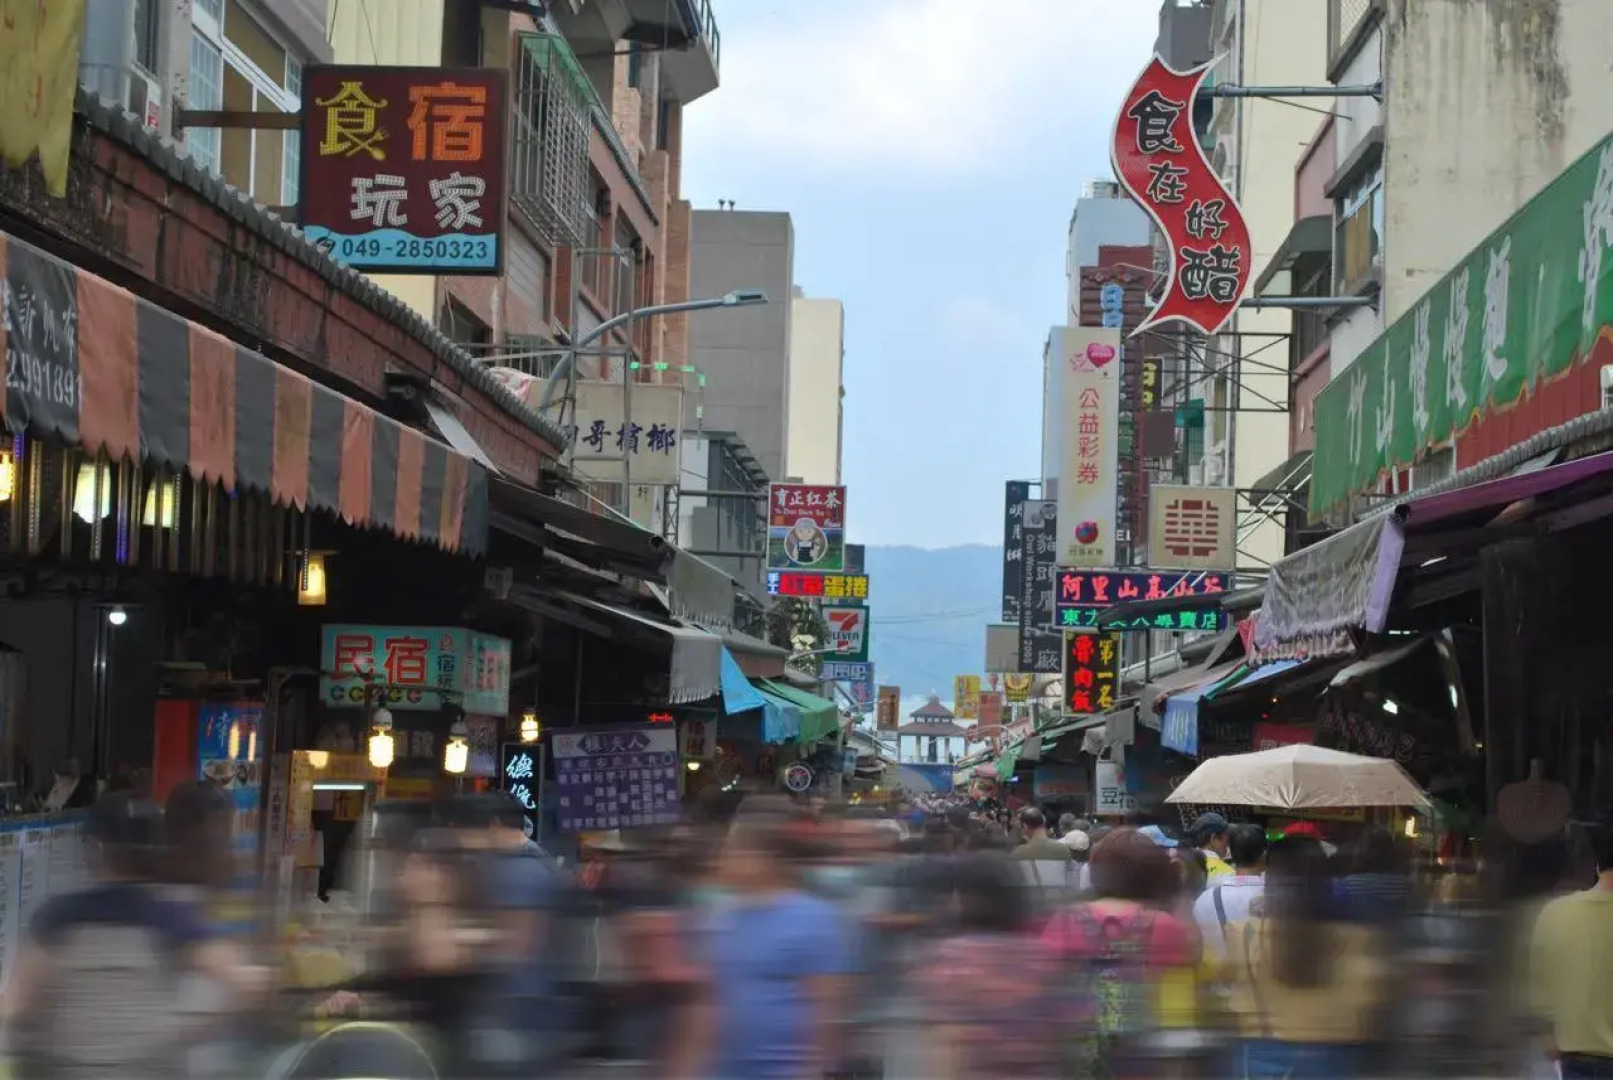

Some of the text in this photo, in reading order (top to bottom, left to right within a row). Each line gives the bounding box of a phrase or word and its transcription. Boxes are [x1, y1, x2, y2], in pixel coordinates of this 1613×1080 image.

[315, 81, 487, 161] 食宿
[350, 171, 486, 230] 玩家
[1128, 90, 1241, 303] 食在好醋
[342, 238, 488, 259] 049-2850323
[562, 419, 676, 456] 哥檳榔
[1079, 387, 1100, 485] 公益彩券
[330, 633, 428, 685] 民宿
